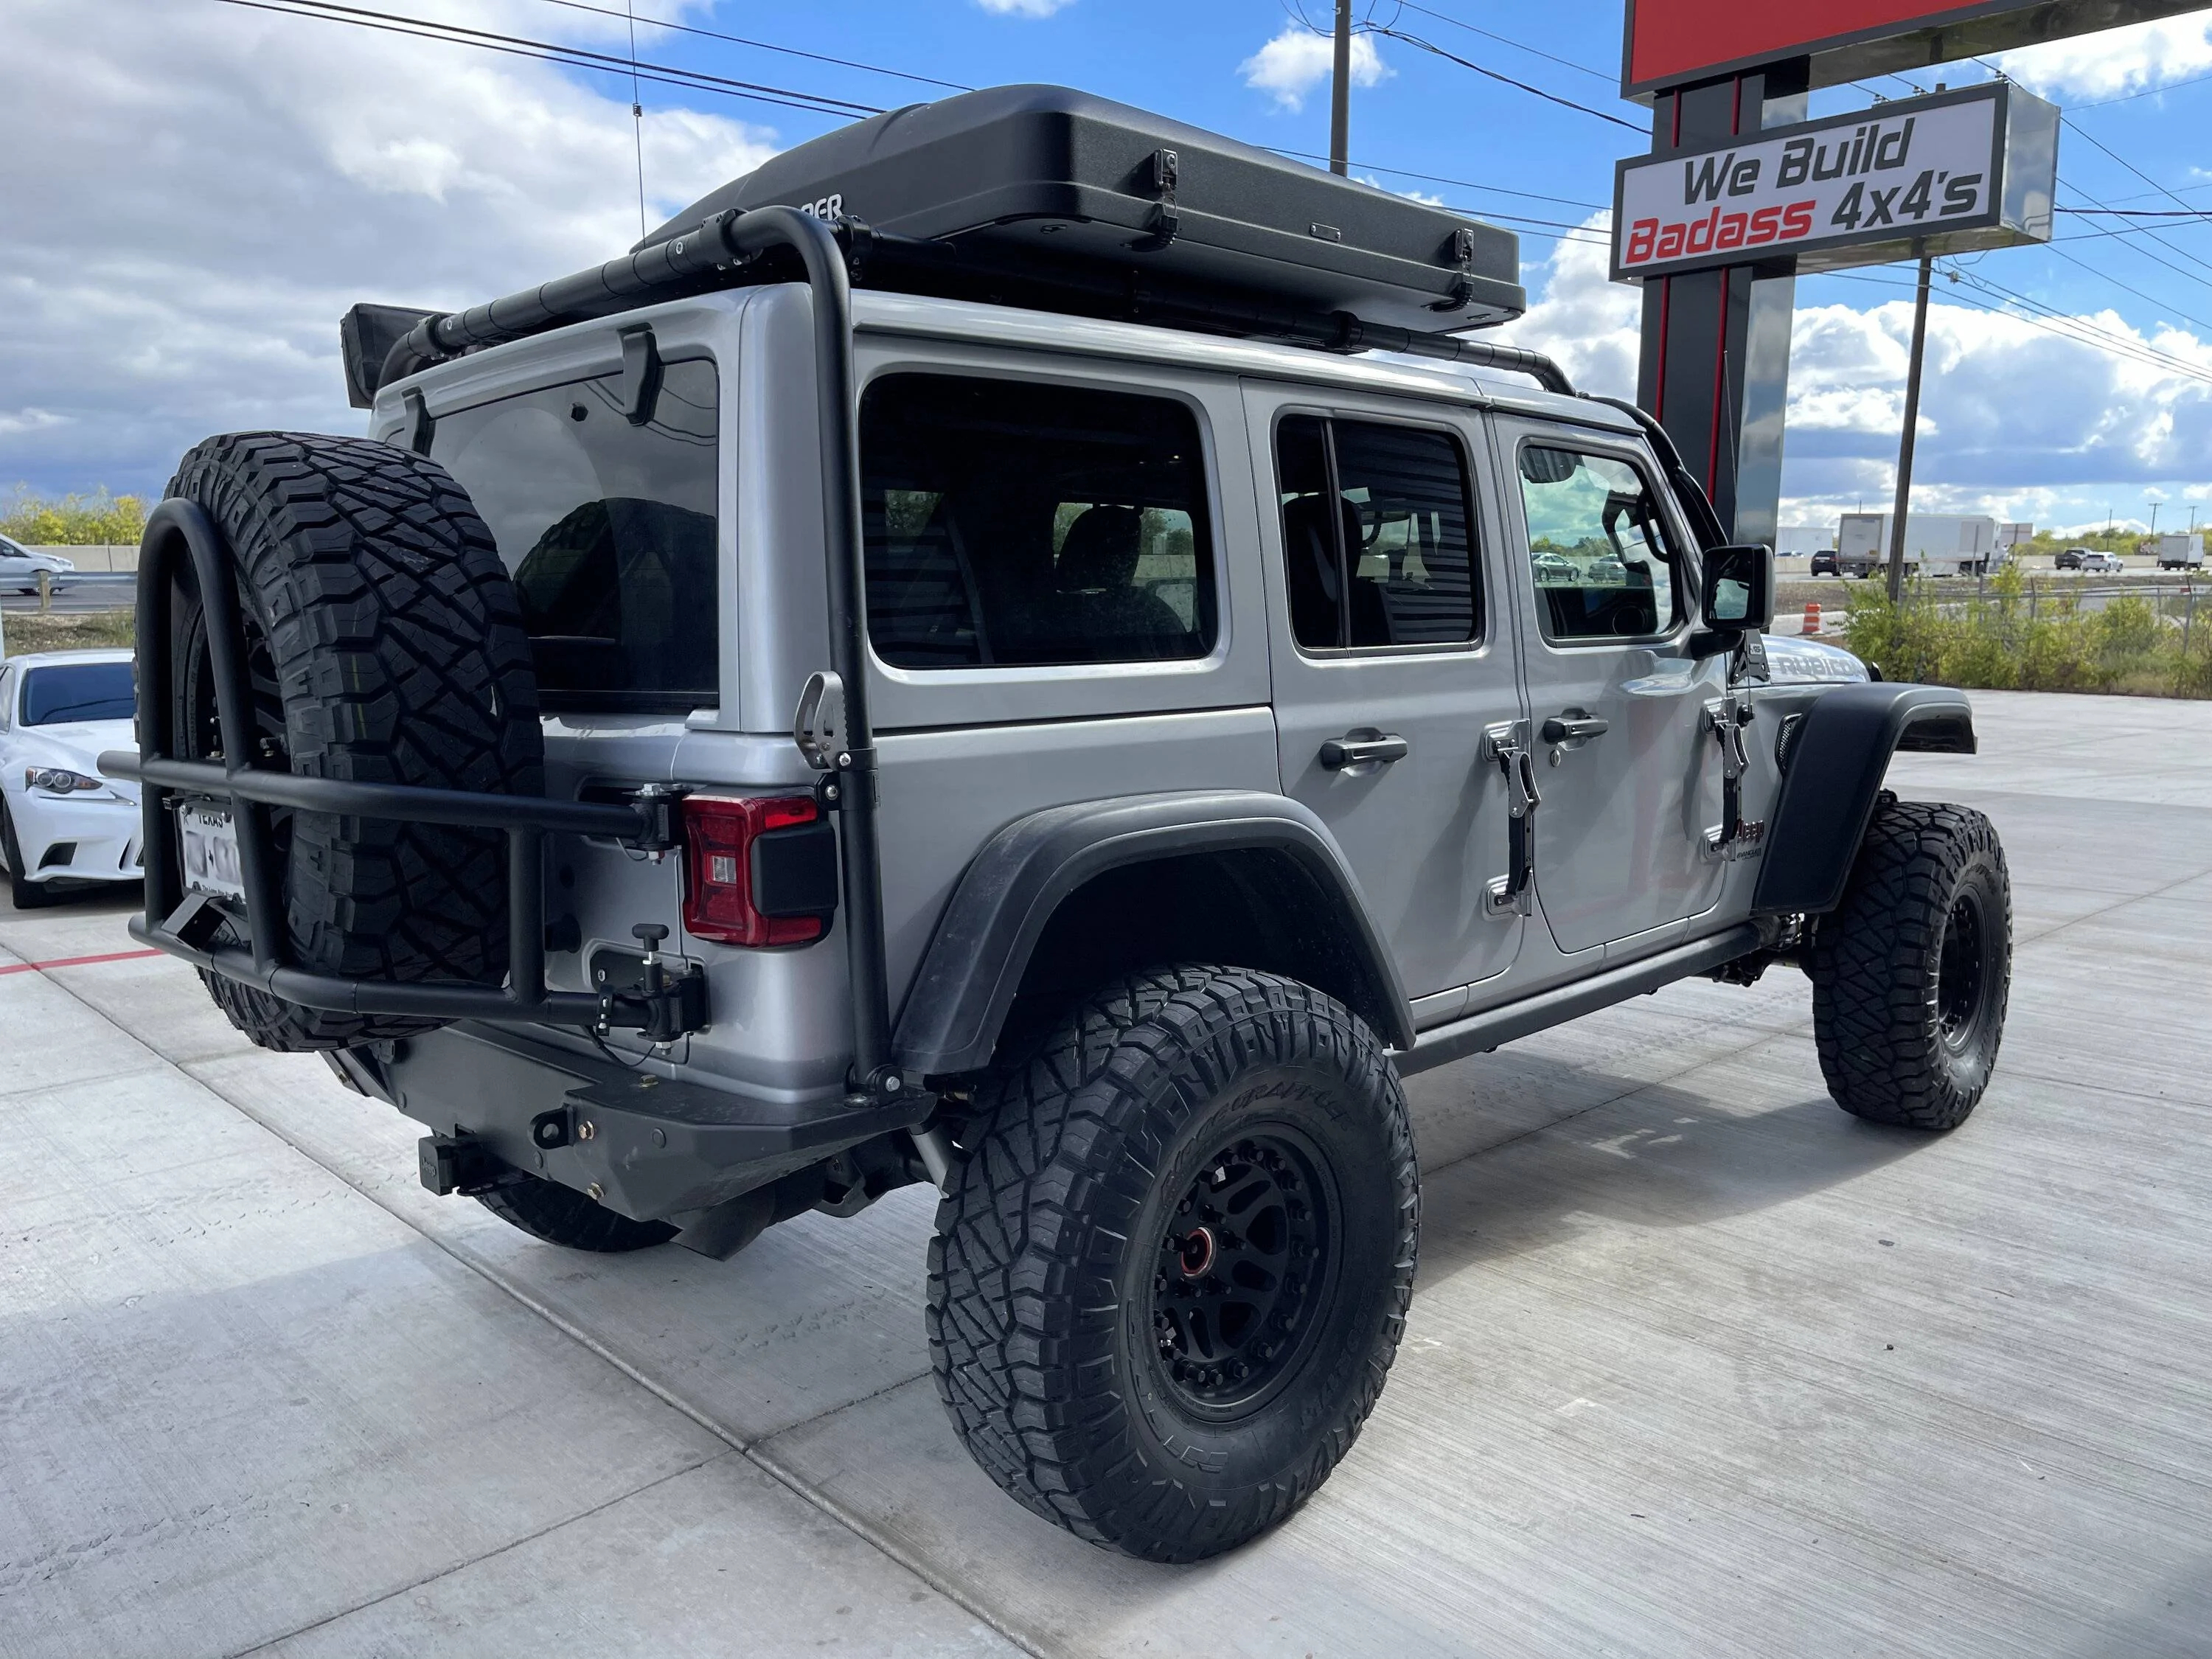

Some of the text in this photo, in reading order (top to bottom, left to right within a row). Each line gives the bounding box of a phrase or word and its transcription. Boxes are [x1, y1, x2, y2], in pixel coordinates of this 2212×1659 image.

[1685, 117, 1915, 205] We Build
[1625, 170, 1983, 264] Badass 4x4's
